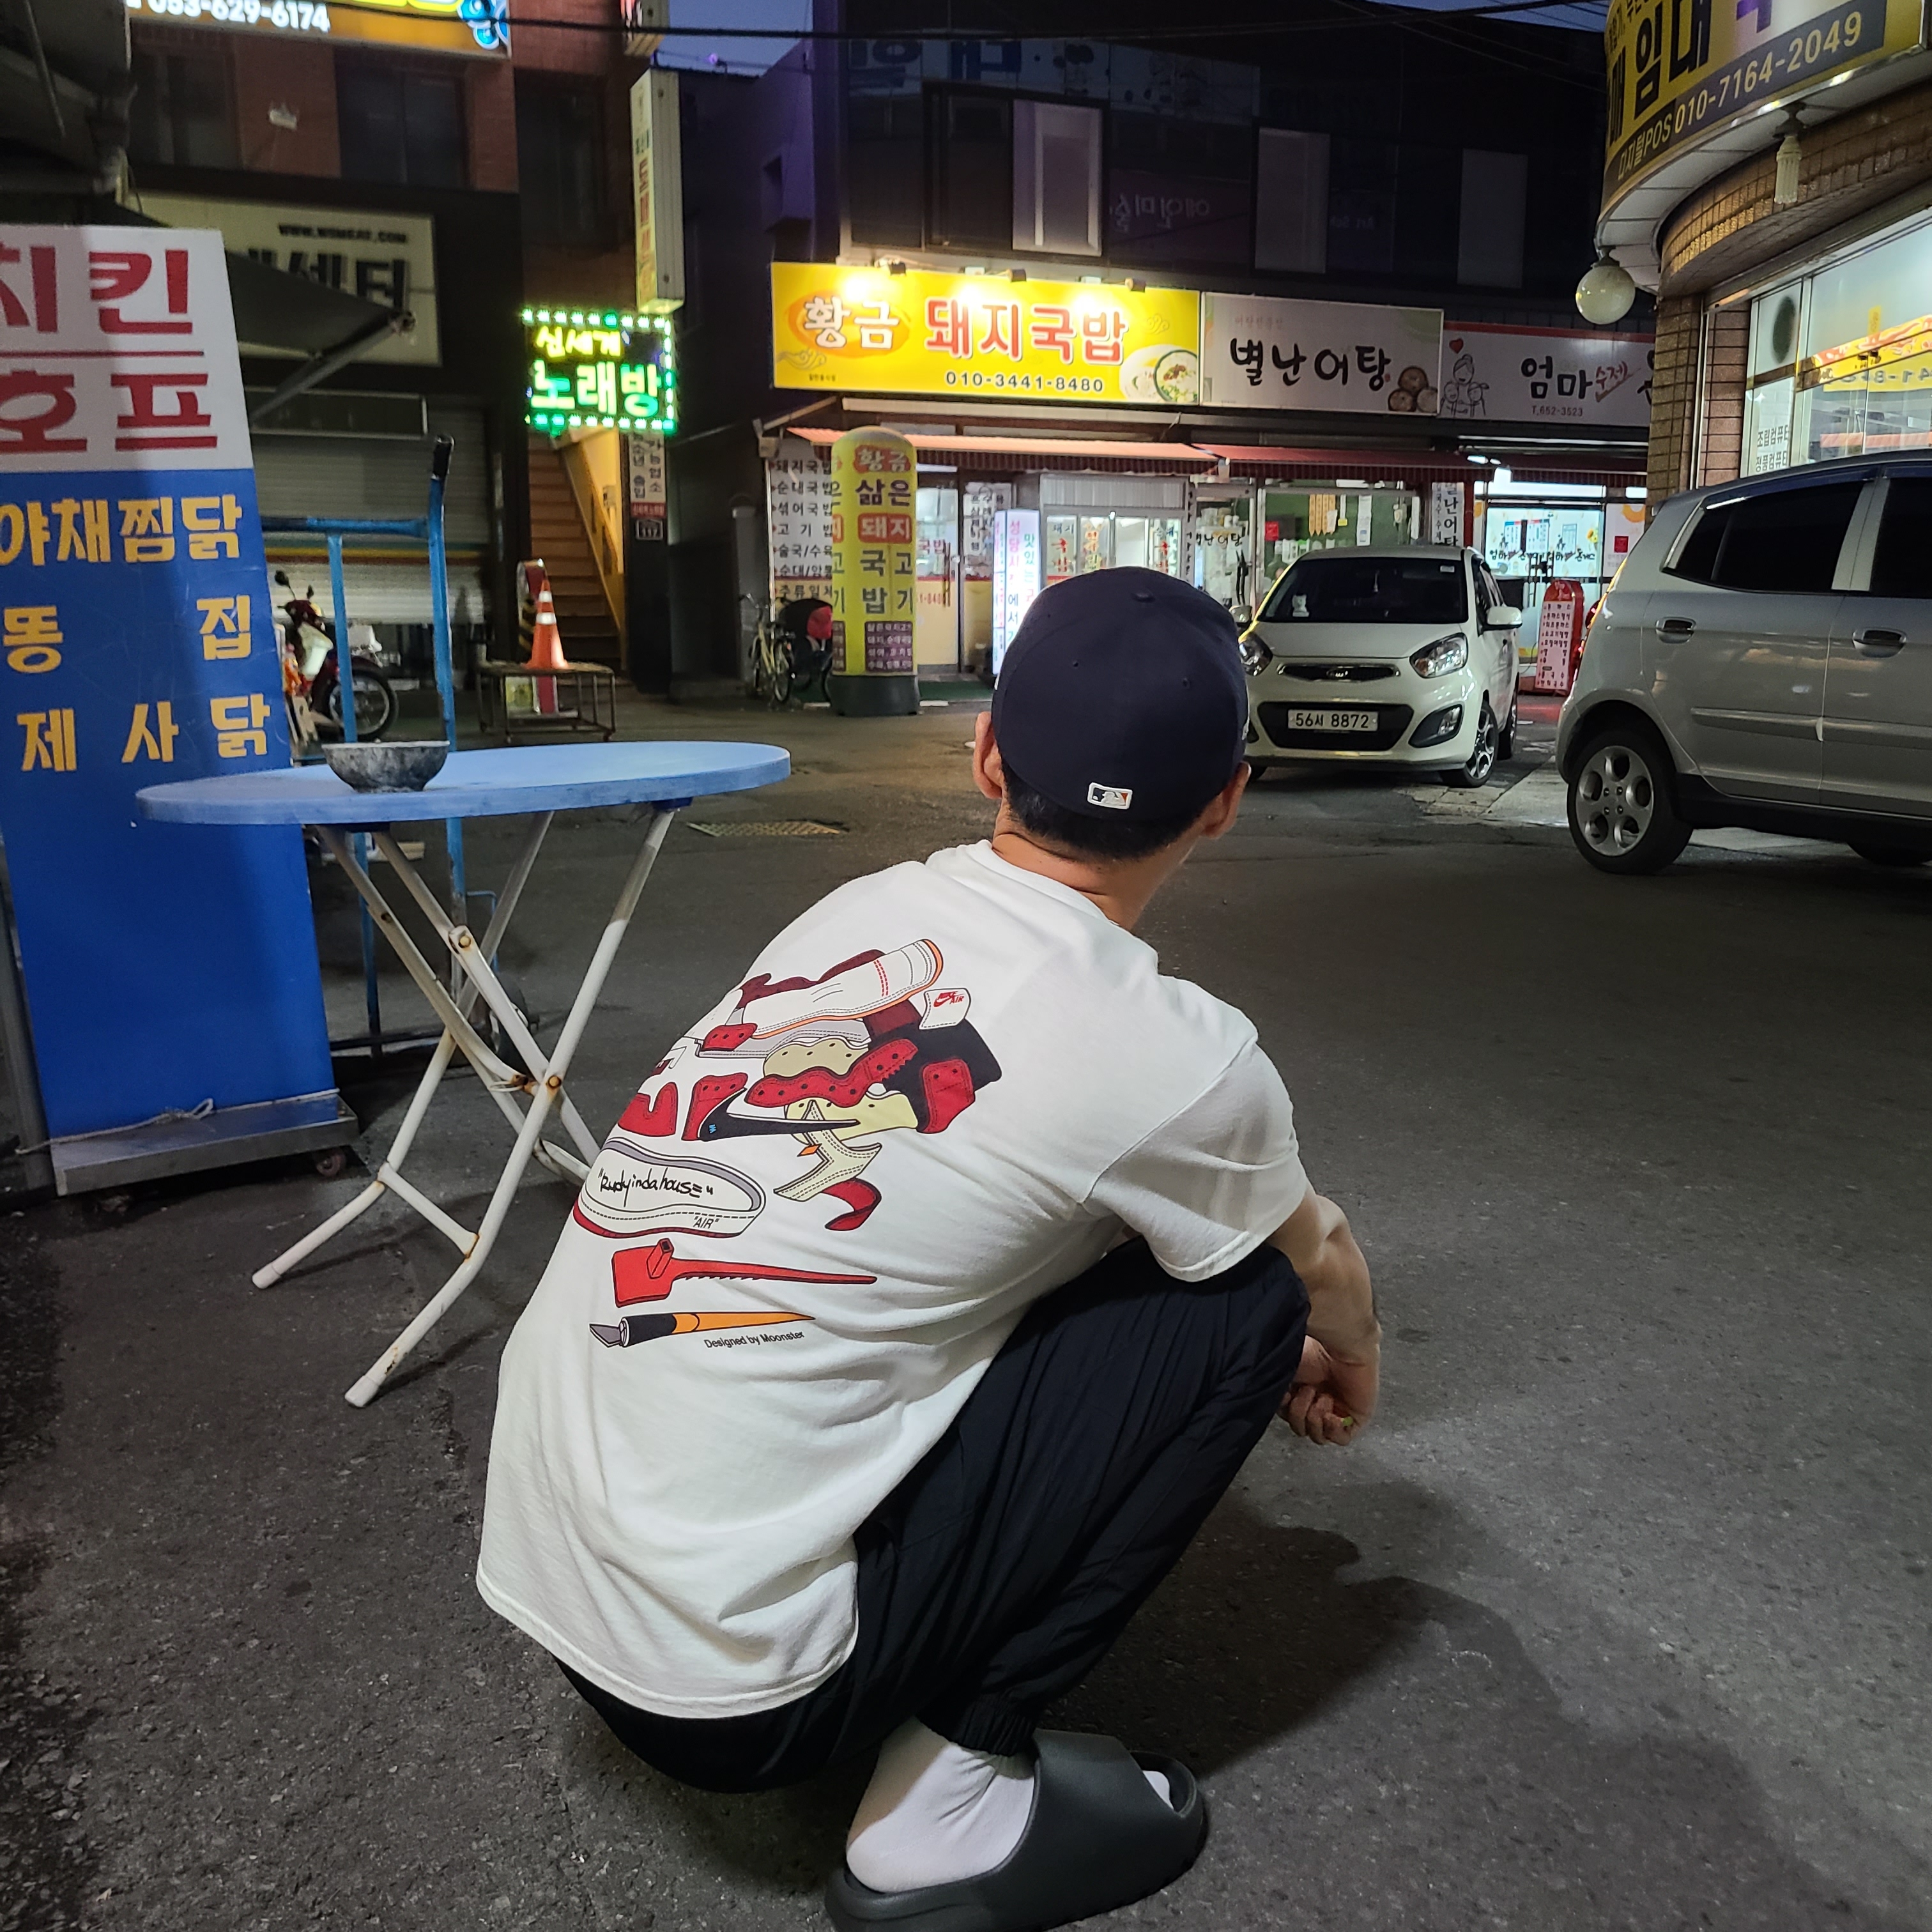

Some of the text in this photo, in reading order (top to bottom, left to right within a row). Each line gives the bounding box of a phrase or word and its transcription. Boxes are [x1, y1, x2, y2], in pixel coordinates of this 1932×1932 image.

[1675, 11, 1862, 134] 010-7164-2049
[536, 325, 621, 358] 신세계
[804, 295, 1130, 366] 황금 돼지국밥
[1230, 337, 1391, 391] 별난어탕
[1521, 356, 1593, 399] 엄마
[531, 359, 662, 417] 노래방
[946, 371, 1104, 393] 010-3441-8480
[859, 448, 907, 472] 황금
[855, 479, 911, 506] 삶은
[0, 494, 242, 567] 야채찜닭
[861, 516, 910, 540] 돼지
[1331, 714, 1368, 728] 8872
[704, 1331, 804, 1348] Designed by Moonster
